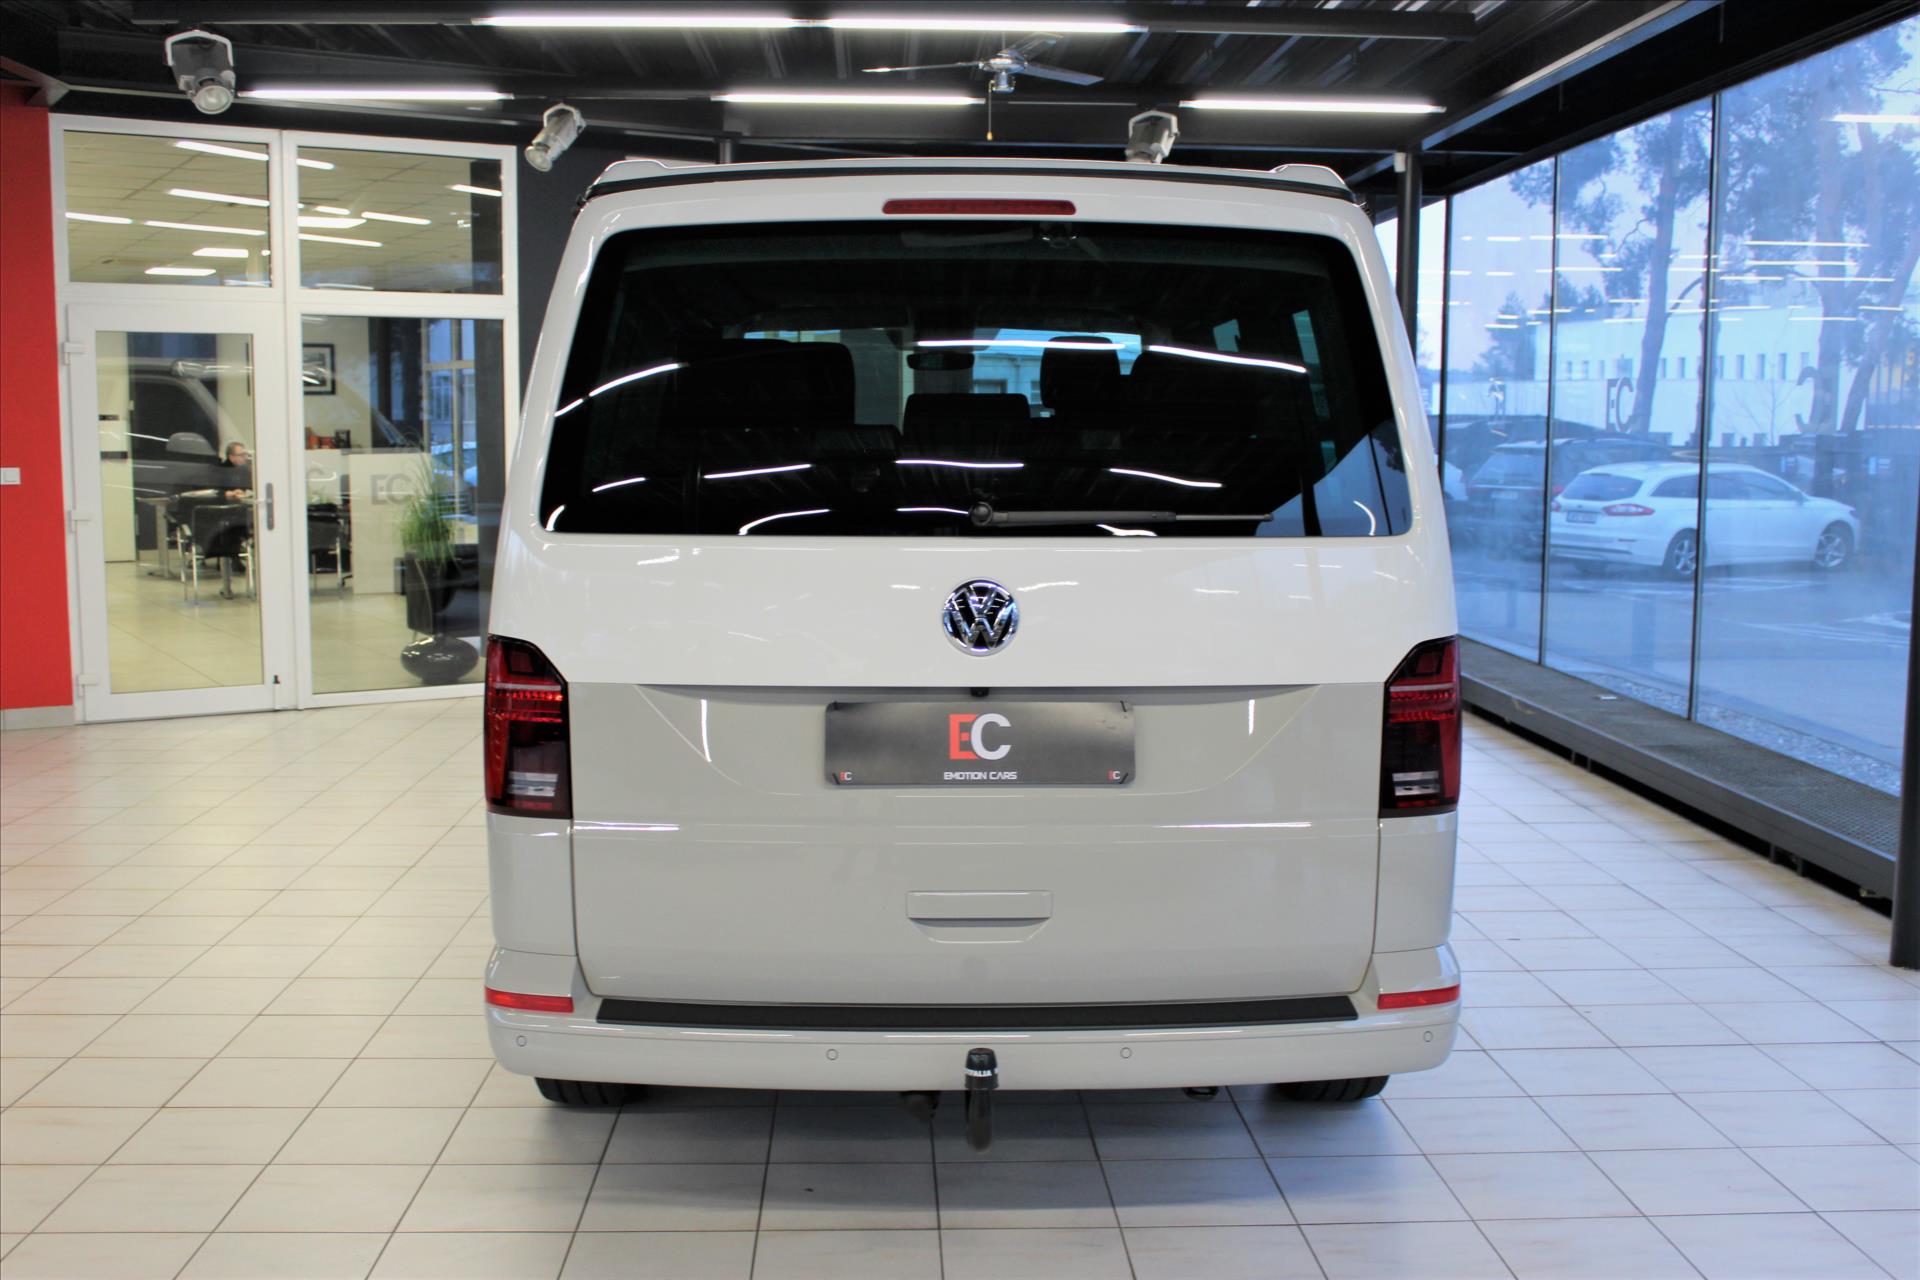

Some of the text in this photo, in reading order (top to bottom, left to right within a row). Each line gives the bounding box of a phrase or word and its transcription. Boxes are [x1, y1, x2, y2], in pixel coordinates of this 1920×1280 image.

[370, 473, 416, 505] EC
[943, 578, 1018, 656] VW
[949, 713, 1011, 760] EC
[944, 771, 1018, 780] EMOTION CARS
